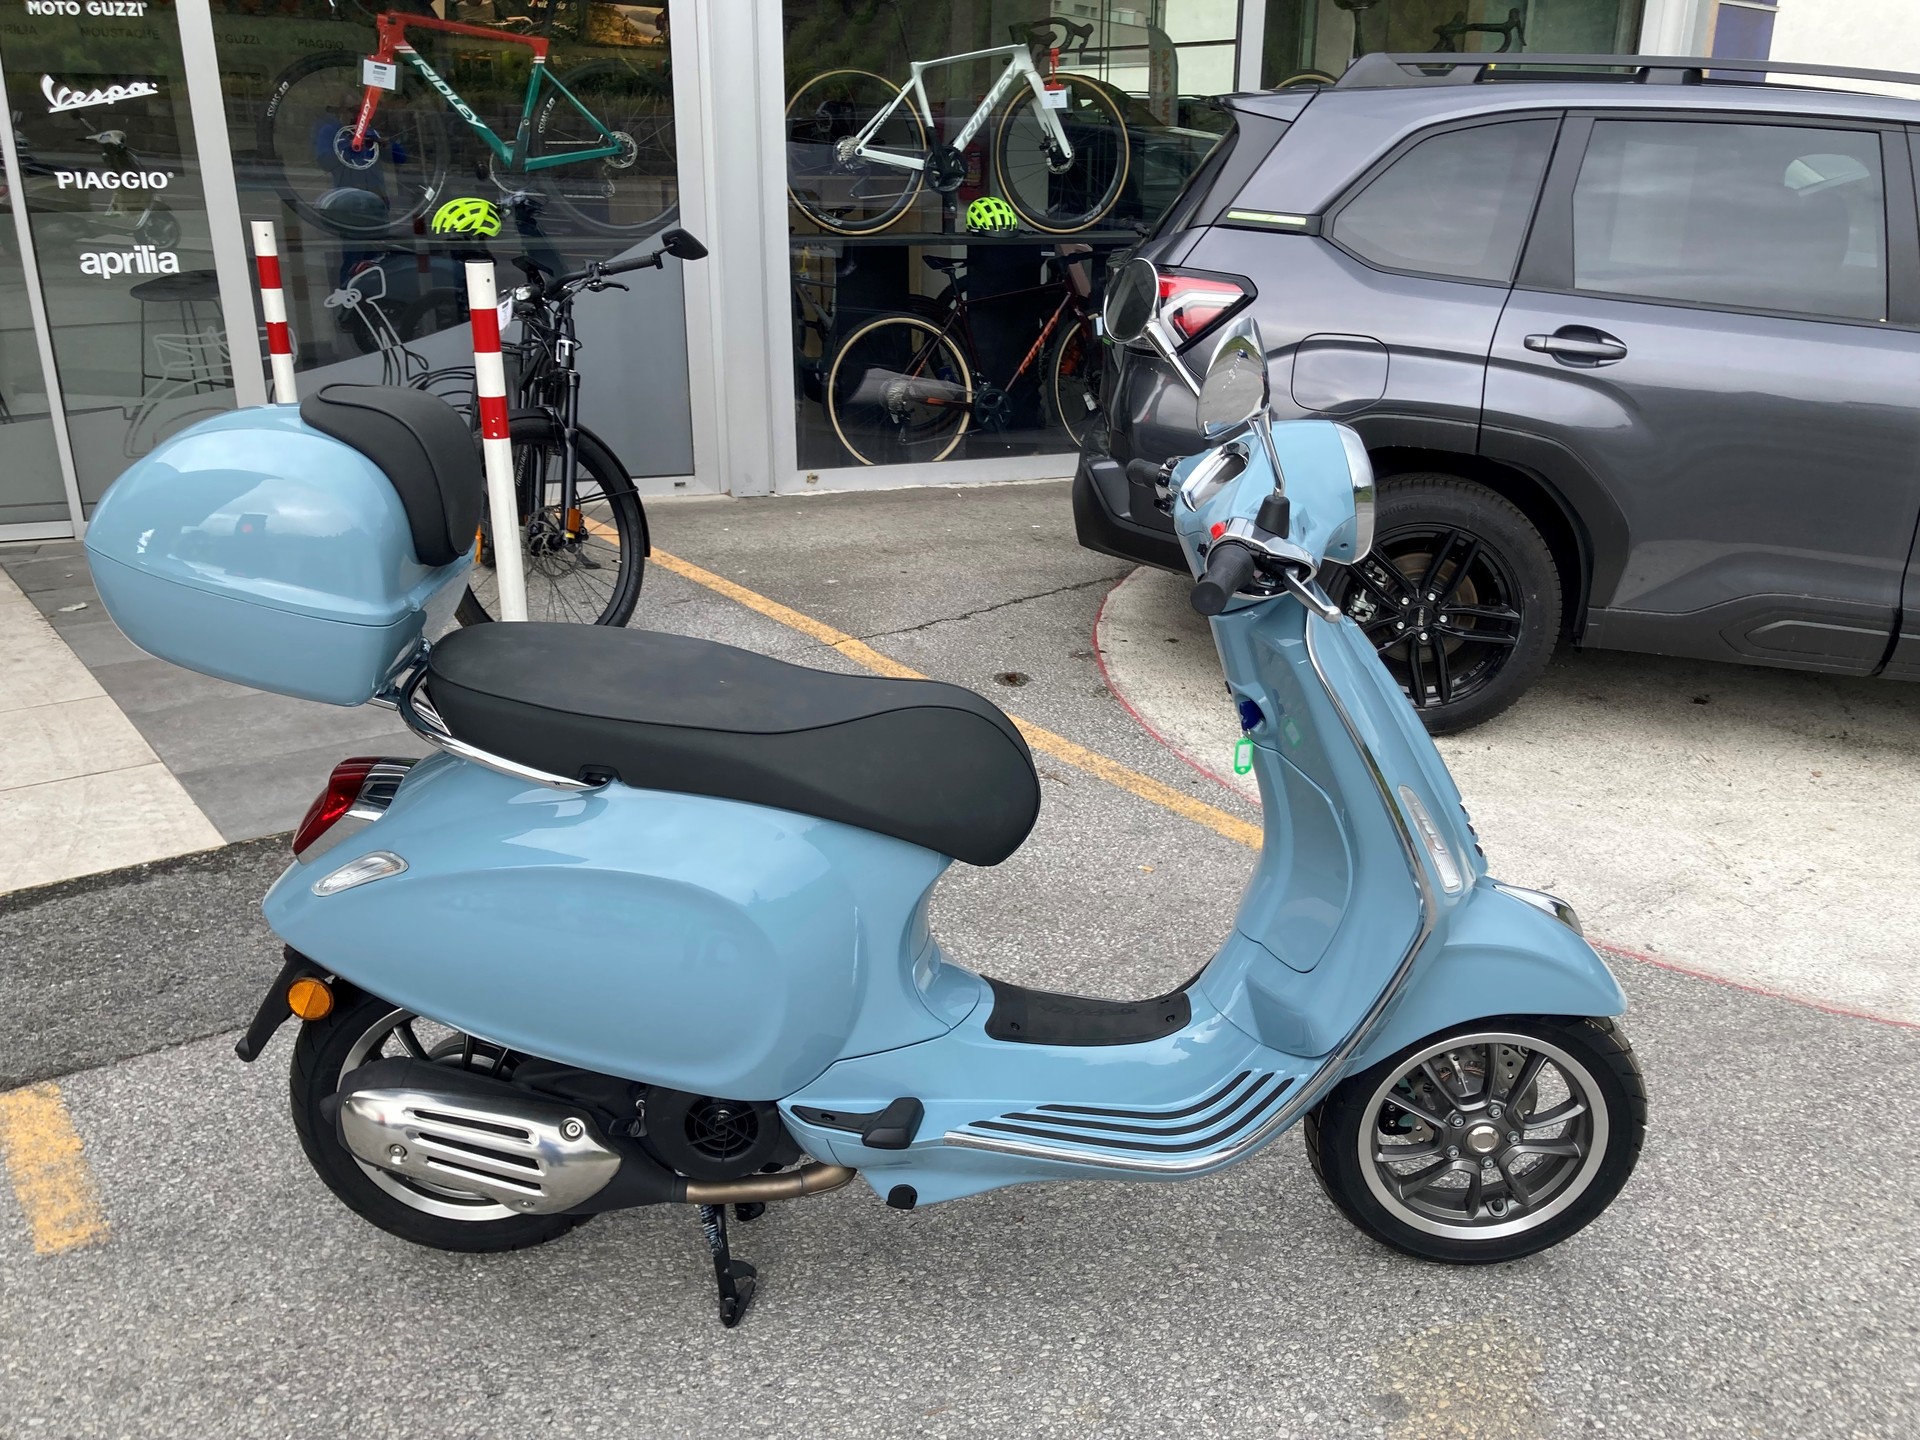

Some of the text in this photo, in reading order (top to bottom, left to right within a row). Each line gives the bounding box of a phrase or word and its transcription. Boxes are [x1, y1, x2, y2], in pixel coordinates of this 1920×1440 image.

[27, 1, 80, 16] MOTO
[40, 74, 158, 113] Vespa
[267, 93, 281, 118] SWISS
[412, 59, 488, 128] RIDLEY
[959, 65, 1018, 145] RIDLEY
[356, 99, 371, 138] RIDLEY
[538, 110, 549, 135] SWISS
[79, 245, 180, 280] aprilia
